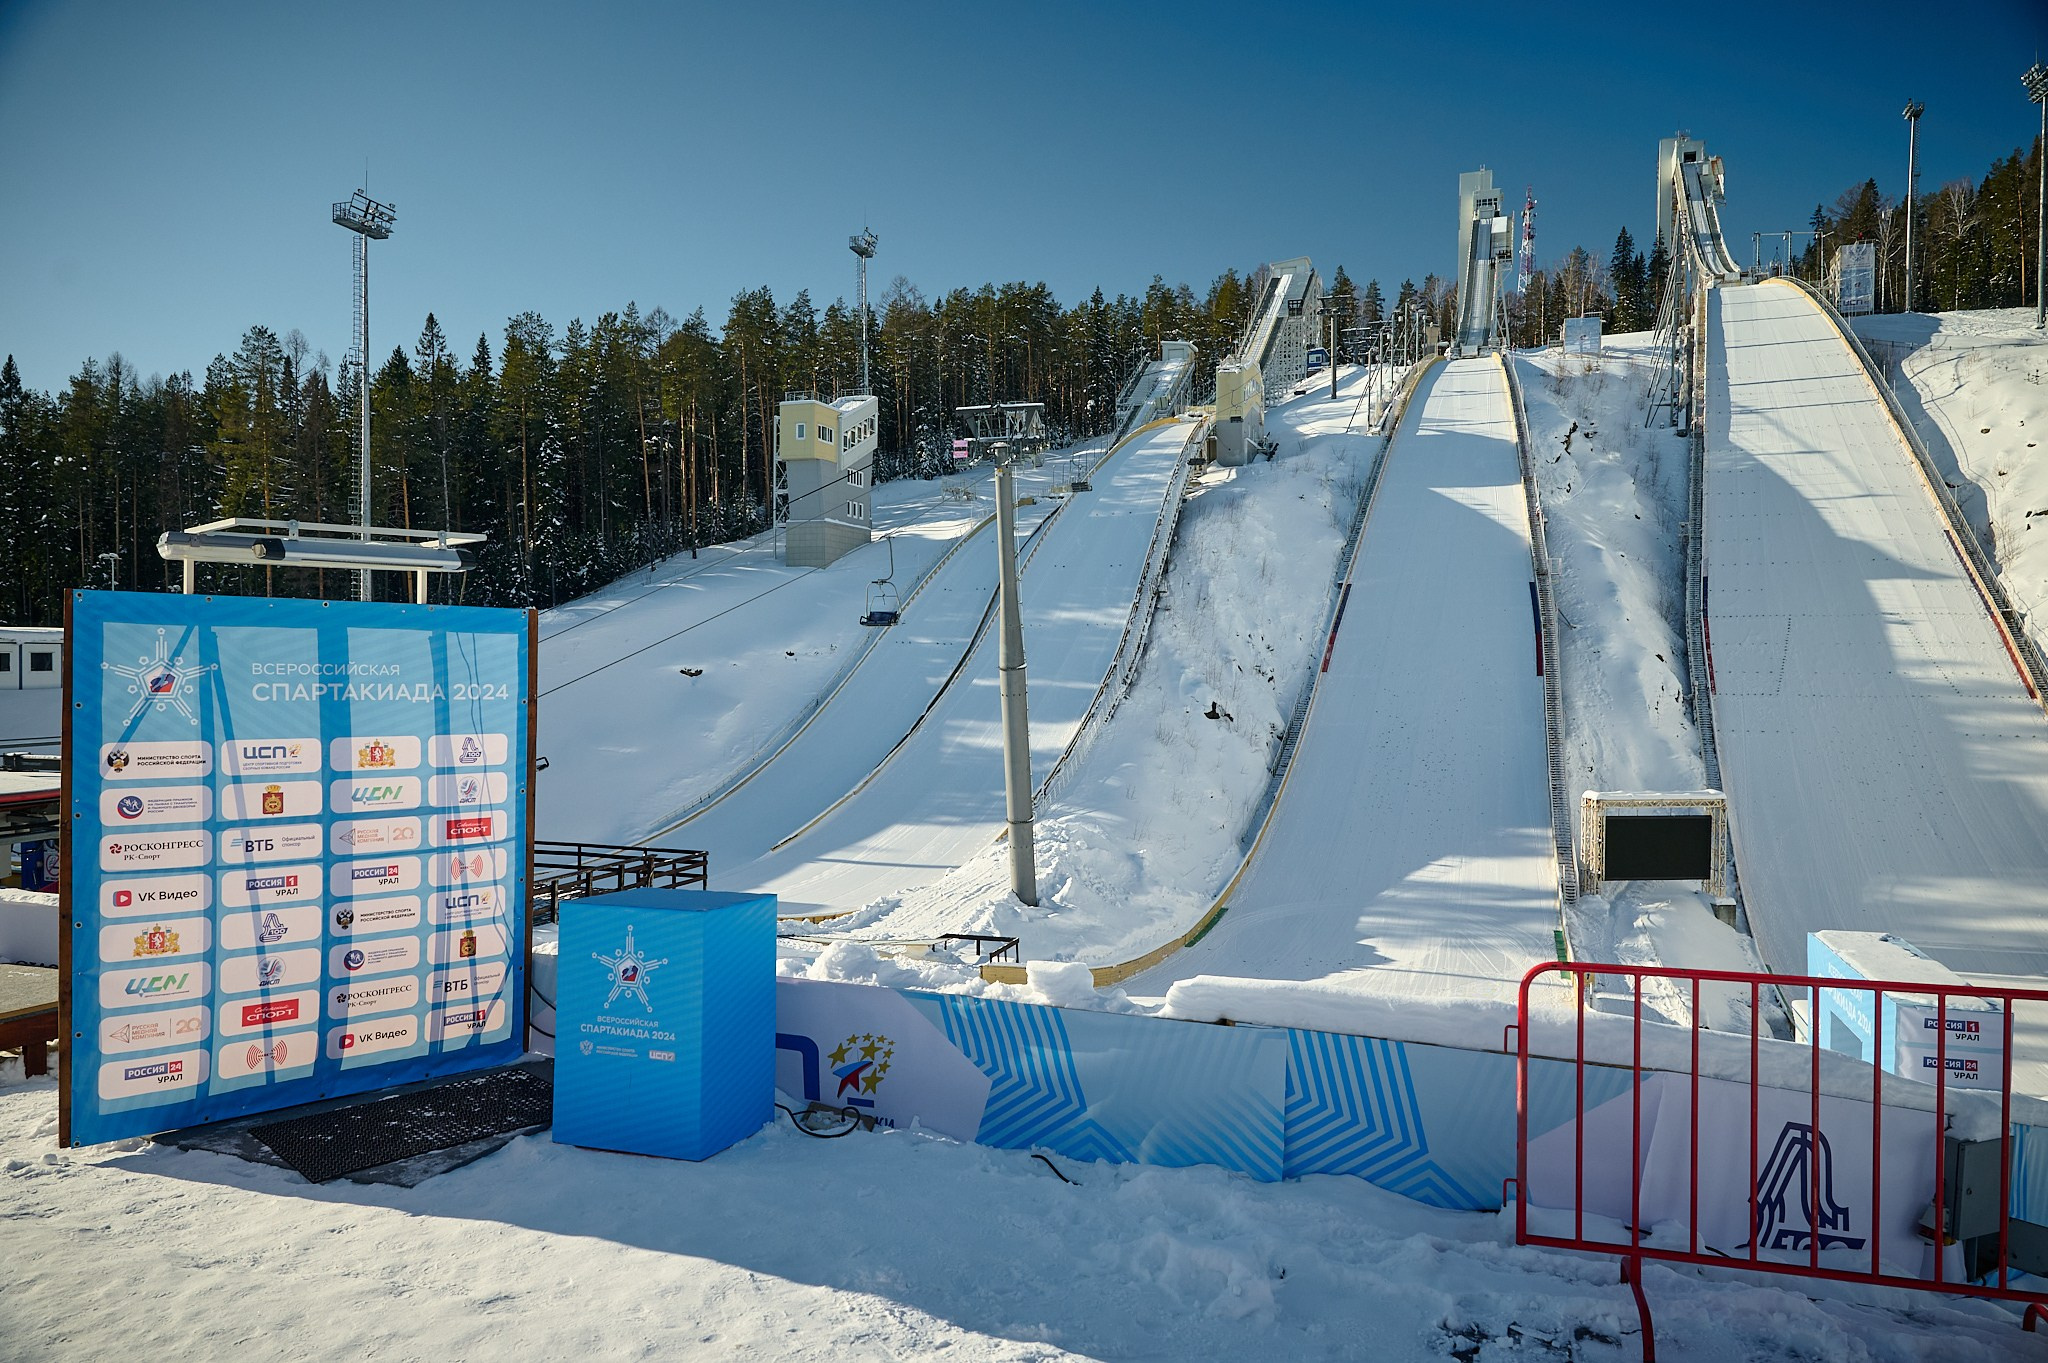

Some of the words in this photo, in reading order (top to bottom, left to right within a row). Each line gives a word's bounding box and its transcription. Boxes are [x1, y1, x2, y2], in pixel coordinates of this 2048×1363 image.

[252, 661, 400, 676] ВСЕРОССИЙСКАЯ
[252, 683, 446, 703] СПАРТАКИАДА
[453, 684, 508, 700] 2024
[244, 746, 286, 759] ЦСП
[451, 826, 488, 835] СПОРТ
[124, 840, 204, 852] РОСКОНГРЕСС
[246, 839, 274, 852] ВТБ
[354, 868, 385, 878] РОССИЯ
[388, 867, 398, 875] 24
[249, 878, 282, 888] РОССИЯ
[288, 877, 294, 886] 1
[378, 877, 399, 885] УРАЛ
[138, 892, 156, 901] VK
[159, 890, 198, 900] Видео
[275, 888, 298, 896] УРАЛ
[445, 894, 479, 909] ЦСП
[444, 979, 468, 993] ВТБ
[347, 984, 412, 1000] РОСКОНГРЕСС
[348, 1000, 377, 1008] РК-Спорт
[247, 1009, 294, 1021] СПОРТ
[446, 1014, 474, 1024] РОССИЯ
[132, 1023, 159, 1031] РУССКАЯ
[467, 1021, 486, 1029] УРАЛ
[597, 1015, 659, 1028] ВСЕРОССИЙСКАЯ
[1928, 1020, 1962, 1030] РОСИЯ
[1970, 1023, 1975, 1031] 1
[132, 1032, 165, 1040] КОМПАНИЯ
[359, 1033, 373, 1042] VK
[375, 1029, 408, 1040] Видео
[580, 1024, 650, 1039] СПАРТАКИАДА
[652, 1031, 676, 1041] 2024
[1955, 1033, 1980, 1041] УРАЛ
[1926, 1059, 1960, 1068] РОСИЯ
[128, 1065, 165, 1078] РОССИЯ
[170, 1063, 182, 1071] 24
[1954, 1072, 1978, 1080] УРАЛ
[157, 1074, 183, 1084] УРАЛ
